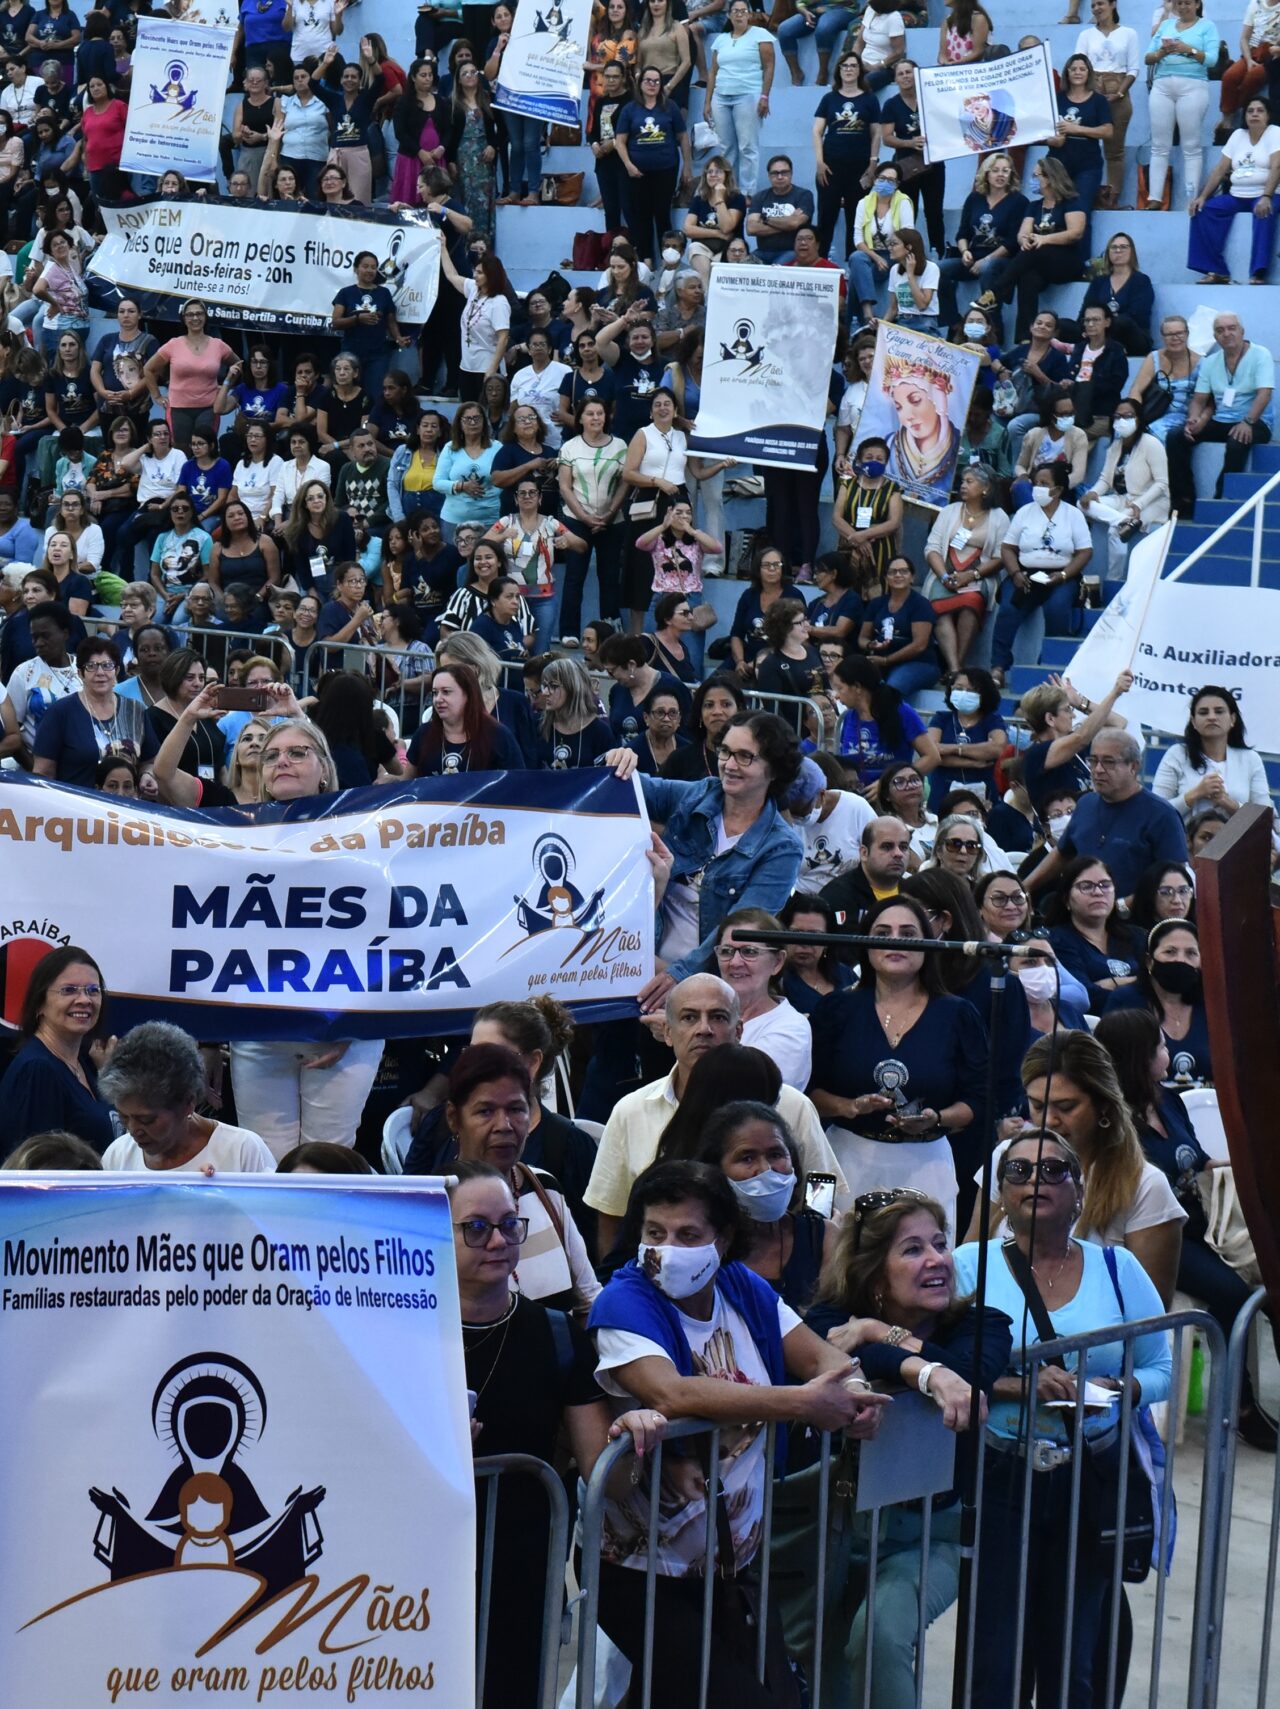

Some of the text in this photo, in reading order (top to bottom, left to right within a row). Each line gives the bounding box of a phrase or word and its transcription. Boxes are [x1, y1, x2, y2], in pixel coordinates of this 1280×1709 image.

[924, 79, 944, 87] PELOS
[980, 72, 1002, 82] CIDADE
[934, 69, 972, 78] MOVIMENTO
[1005, 59, 1016, 68] QUE
[154, 236, 182, 257] que
[190, 232, 240, 260] Oram
[244, 239, 296, 264] pelos
[304, 240, 354, 269] filhos
[148, 257, 252, 281] Segundas-feiras
[265, 266, 293, 284] 20h
[716, 276, 750, 286] MOVIMENTO
[751, 276, 766, 288] MÃES
[767, 279, 778, 288] QUE
[779, 280, 795, 290] ORAM
[796, 281, 814, 292] PELOS
[815, 283, 834, 293] FILHOS
[173, 277, 251, 295] Junte-se a nós!
[214, 307, 241, 320] Santa
[242, 310, 277, 323] Bertila
[285, 313, 322, 327] Curitiba
[1138, 642, 1280, 668] ra. Auxiliadora
[1131, 672, 1199, 697] rizonte
[310, 833, 367, 854] da
[379, 813, 506, 849] Paraíba
[171, 872, 469, 929] MÃES DA
[169, 935, 471, 993] PARAÍBA
[528, 961, 642, 991] que oram pelos filhos
[3, 1232, 435, 1281] Movimento Mães que Oram pelos Filhos
[2, 1283, 438, 1312] Famílias restauradas pelo poder da Oração de Intercessão
[195, 1573, 431, 1659] Mães
[106, 1656, 435, 1703] que oram pelos filhos
